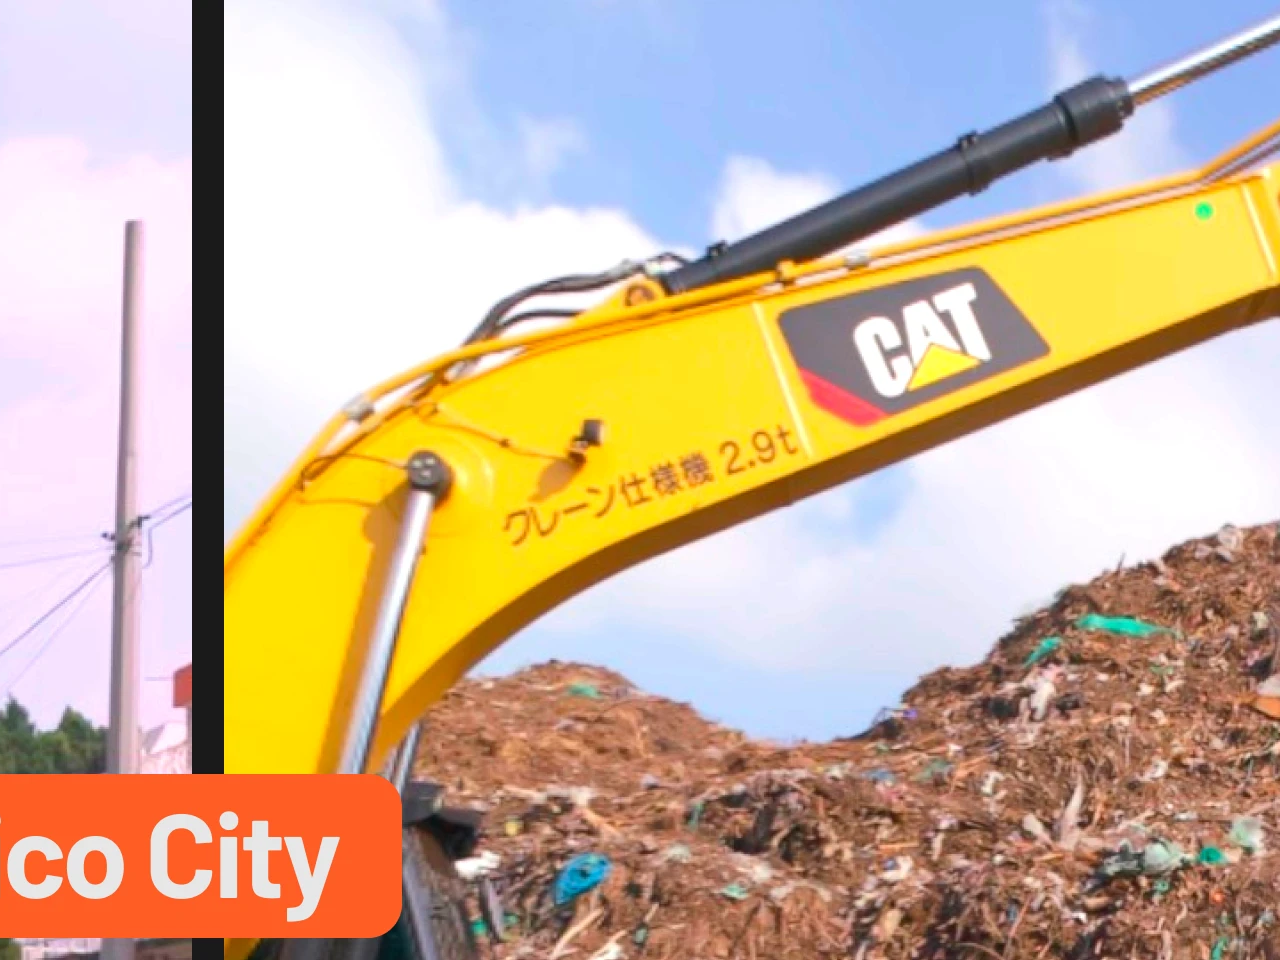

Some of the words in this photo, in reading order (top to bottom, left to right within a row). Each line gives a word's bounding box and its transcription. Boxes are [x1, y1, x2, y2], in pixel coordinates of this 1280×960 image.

[852, 282, 993, 398] CAT
[503, 451, 715, 546] クレーン仕様機
[719, 424, 798, 476] 2.9t
